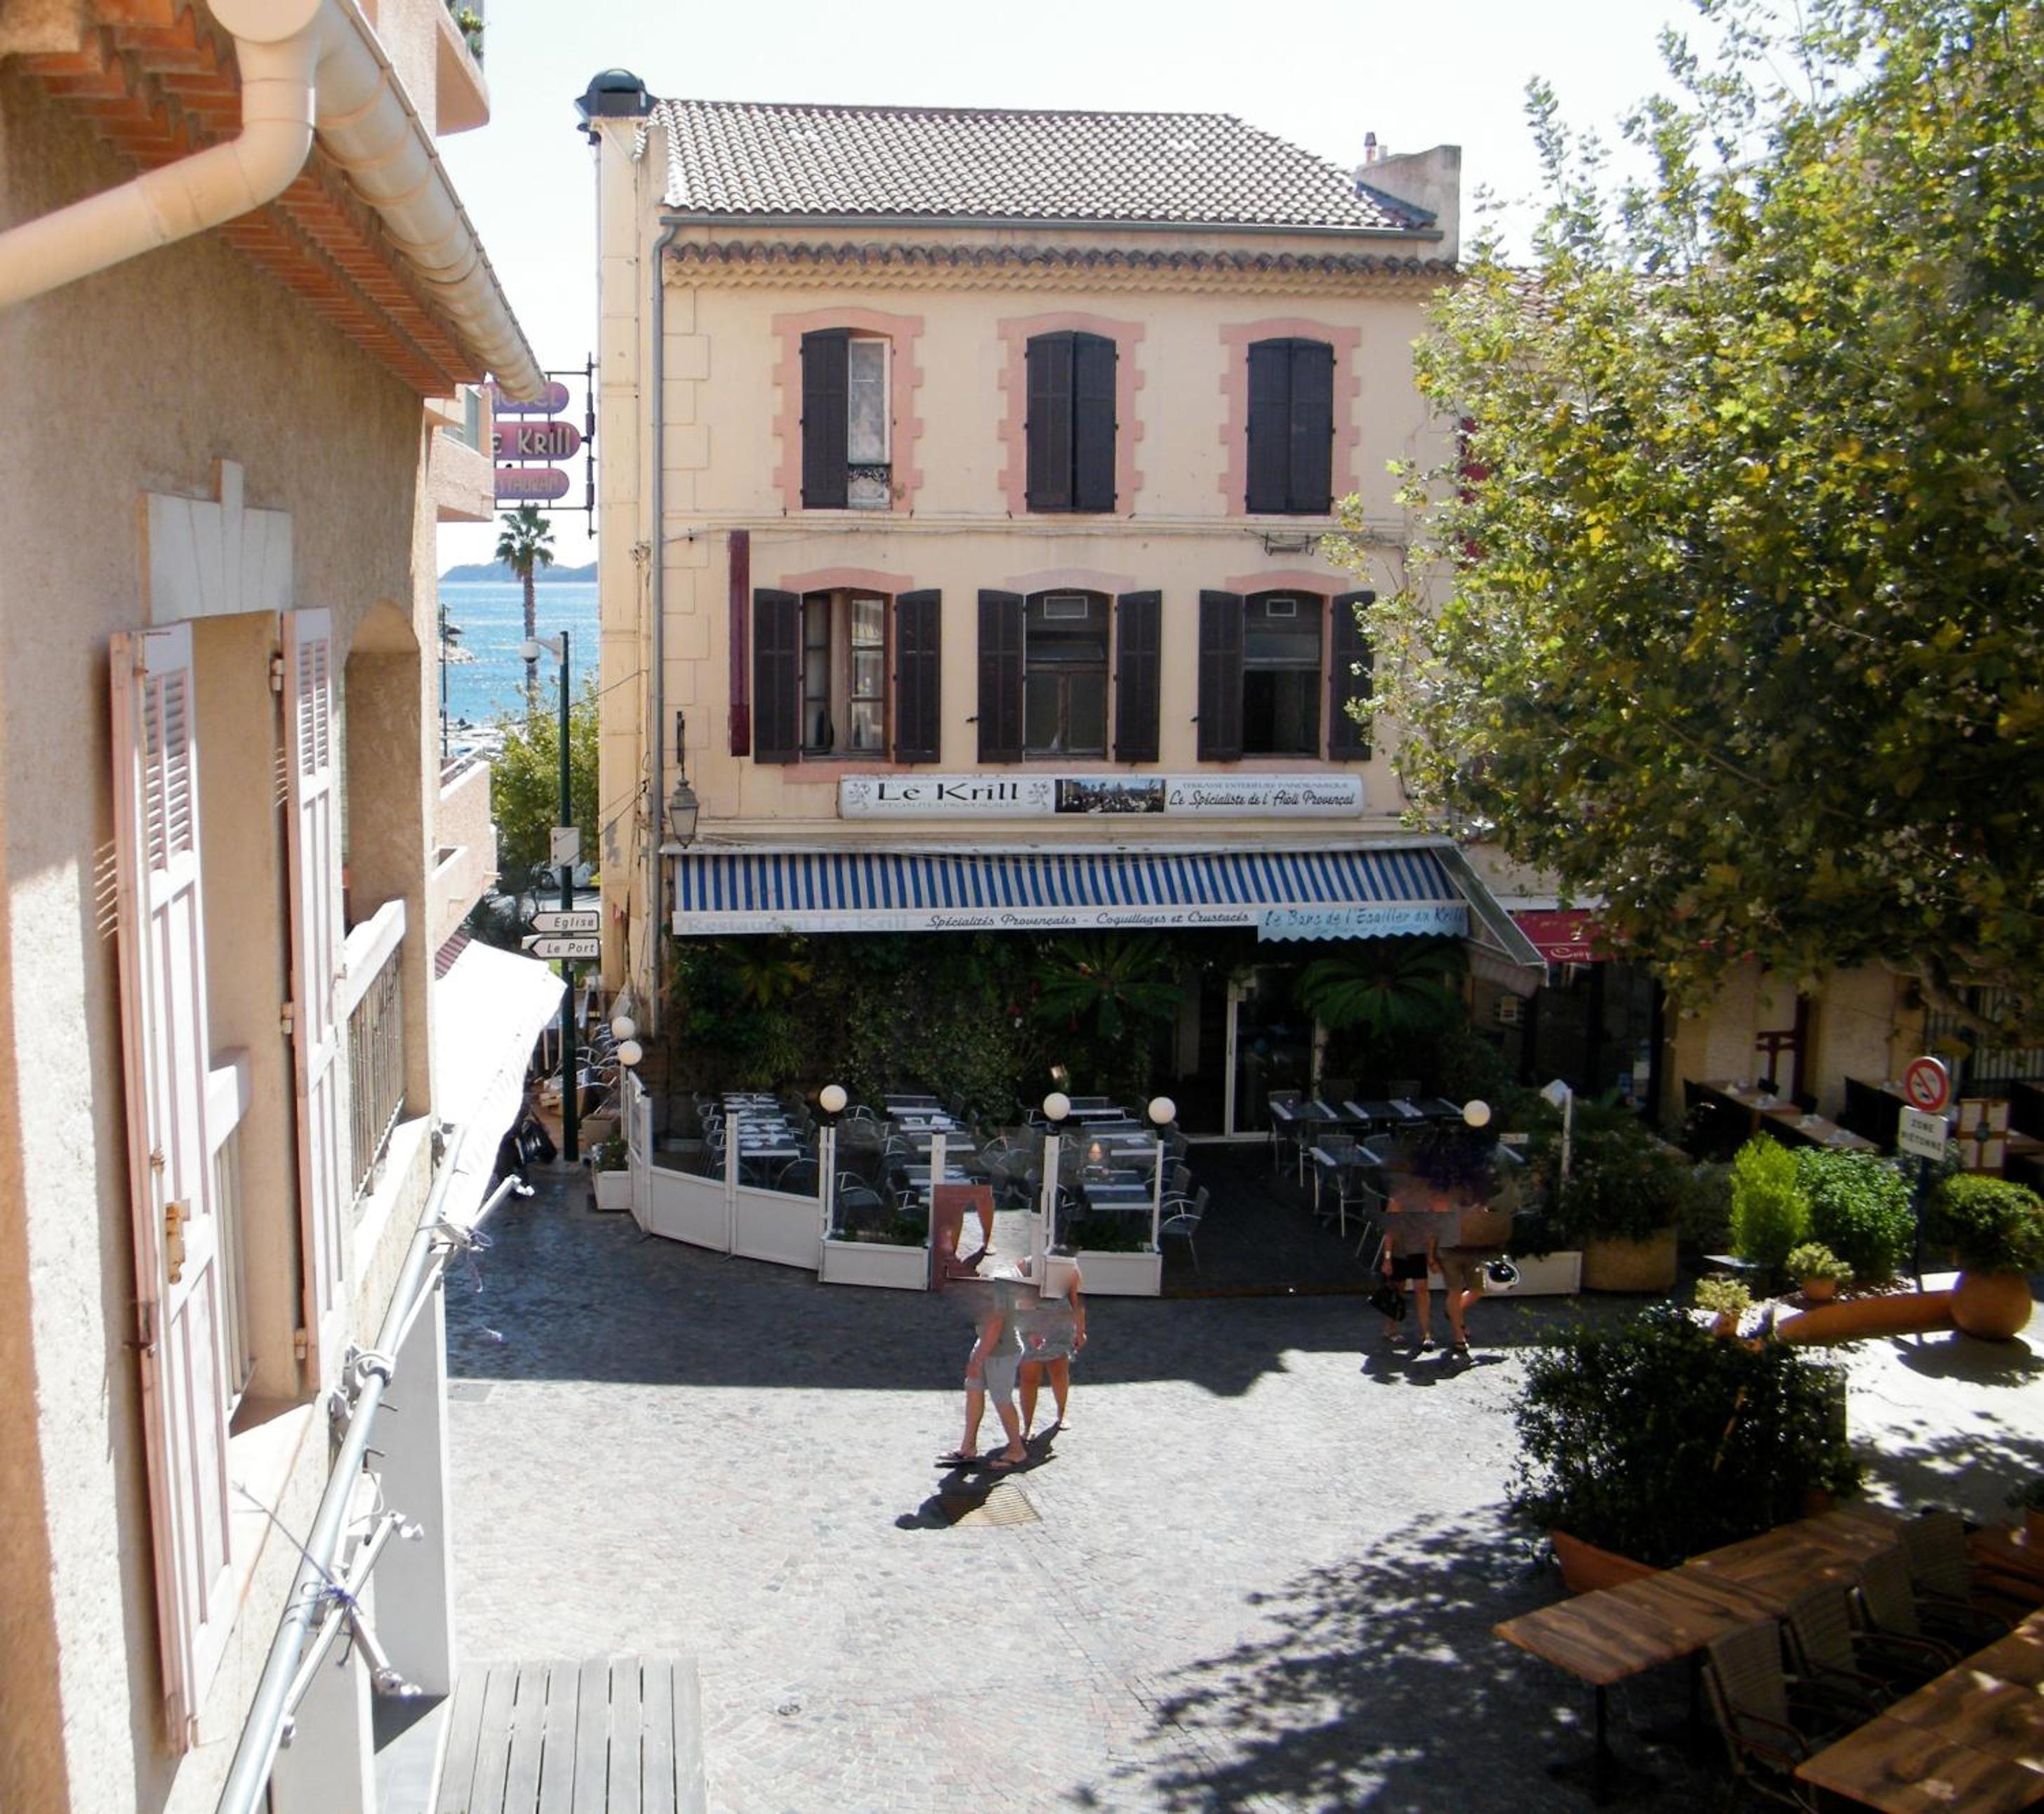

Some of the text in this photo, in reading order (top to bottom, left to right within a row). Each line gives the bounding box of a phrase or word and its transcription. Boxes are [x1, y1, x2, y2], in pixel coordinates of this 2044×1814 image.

[878, 783, 1018, 800] Le Krill
[554, 917, 595, 929] Eglise
[1096, 913, 1167, 927] Coquillages
[1171, 914, 1184, 923] et
[547, 942, 595, 954] Le Port
